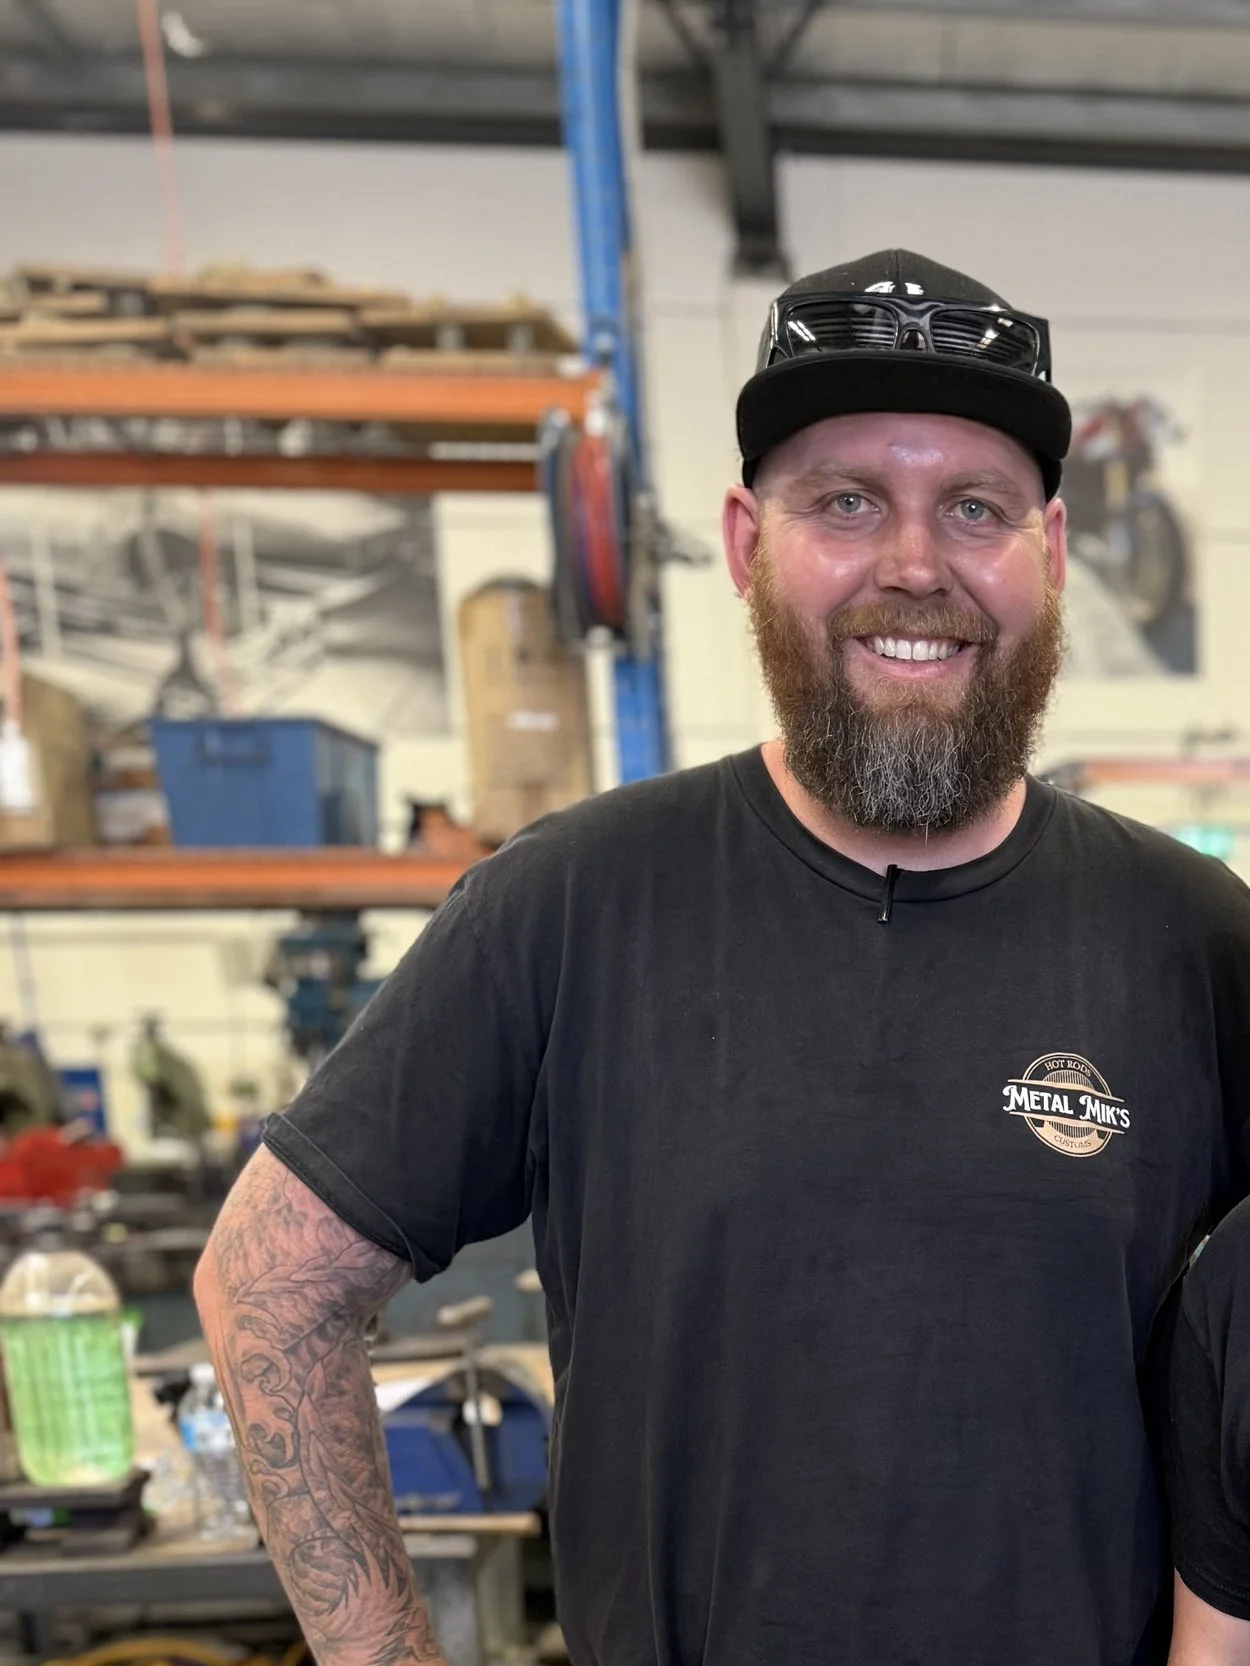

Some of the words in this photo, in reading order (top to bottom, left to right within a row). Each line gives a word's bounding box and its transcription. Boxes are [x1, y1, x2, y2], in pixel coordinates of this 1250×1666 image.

[1044, 1060, 1065, 1071] HOT
[1067, 1061, 1091, 1077] RODS
[1002, 1084, 1074, 1115] METAL
[1054, 1135, 1092, 1149] CUSTOMS
